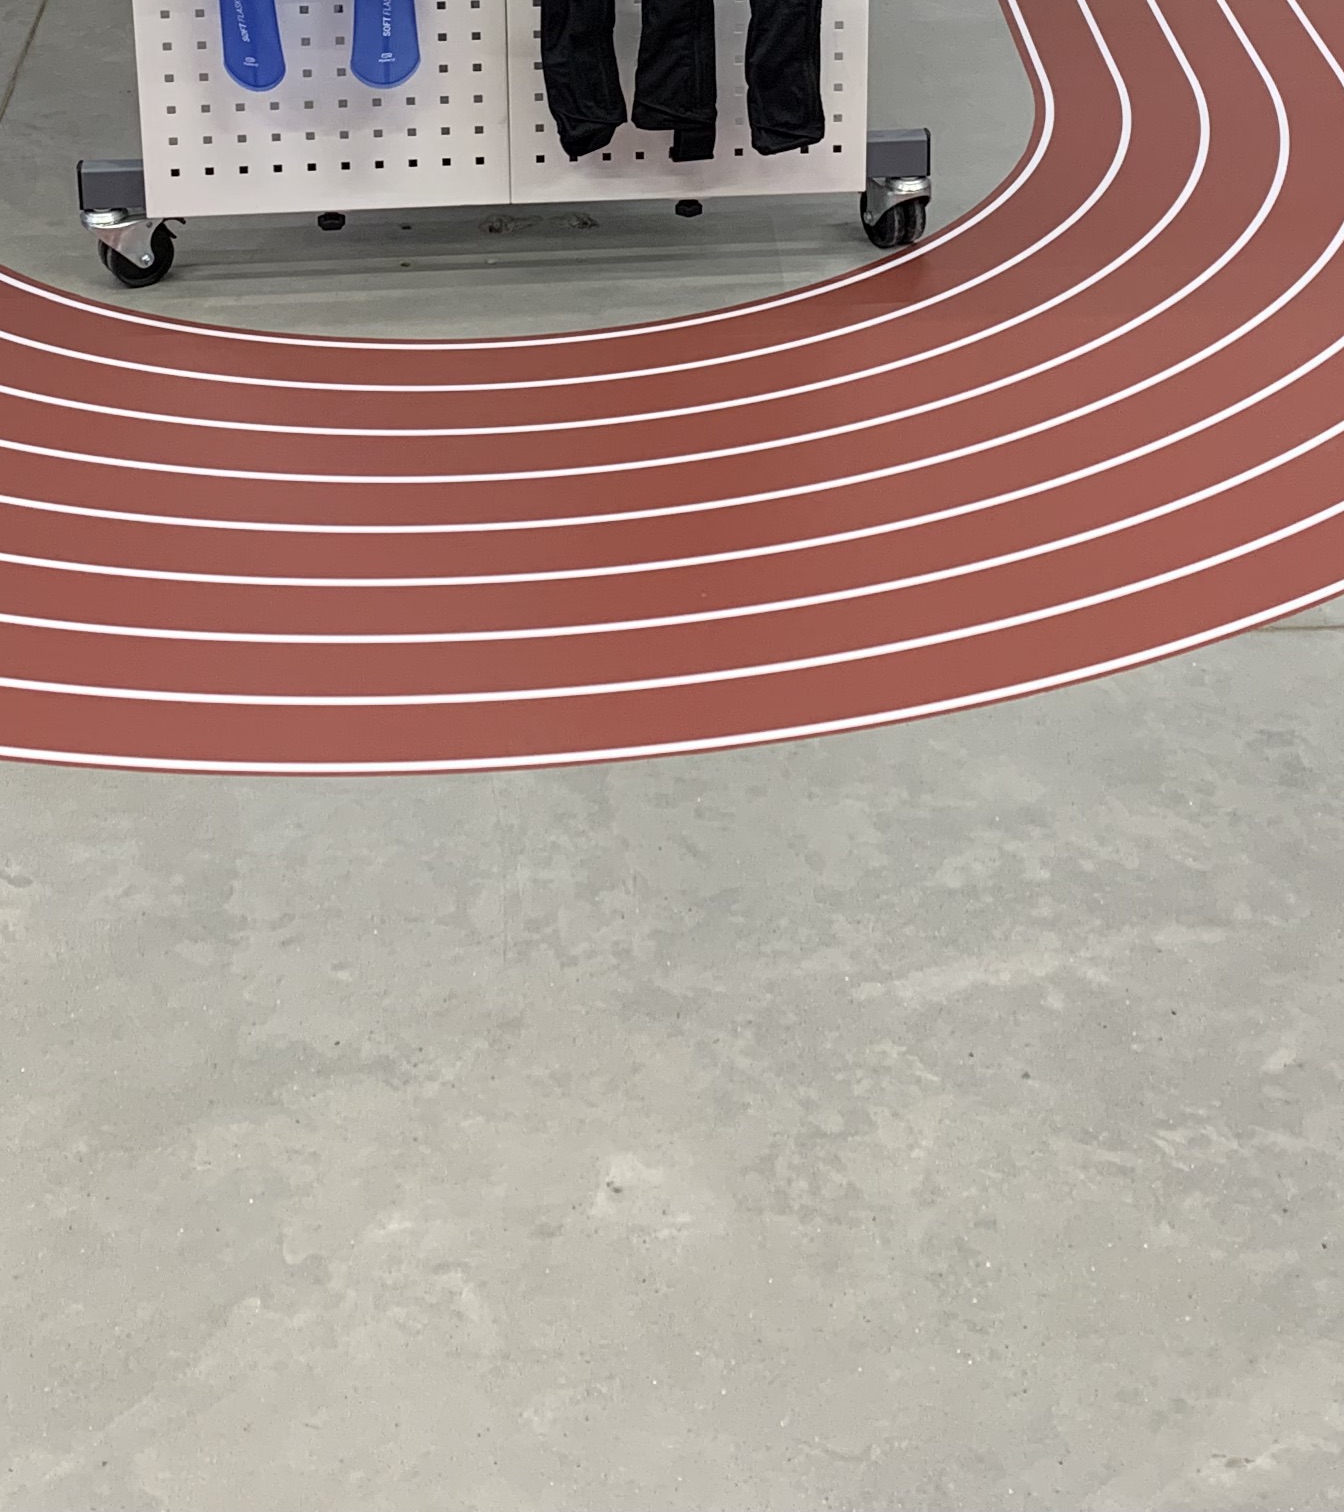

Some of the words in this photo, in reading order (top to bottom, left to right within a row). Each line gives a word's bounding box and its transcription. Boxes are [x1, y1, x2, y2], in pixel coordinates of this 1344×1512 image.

[235, 0, 245, 24] FLASK
[238, 23, 250, 42] SOFT
[383, 16, 391, 37] SOFT
